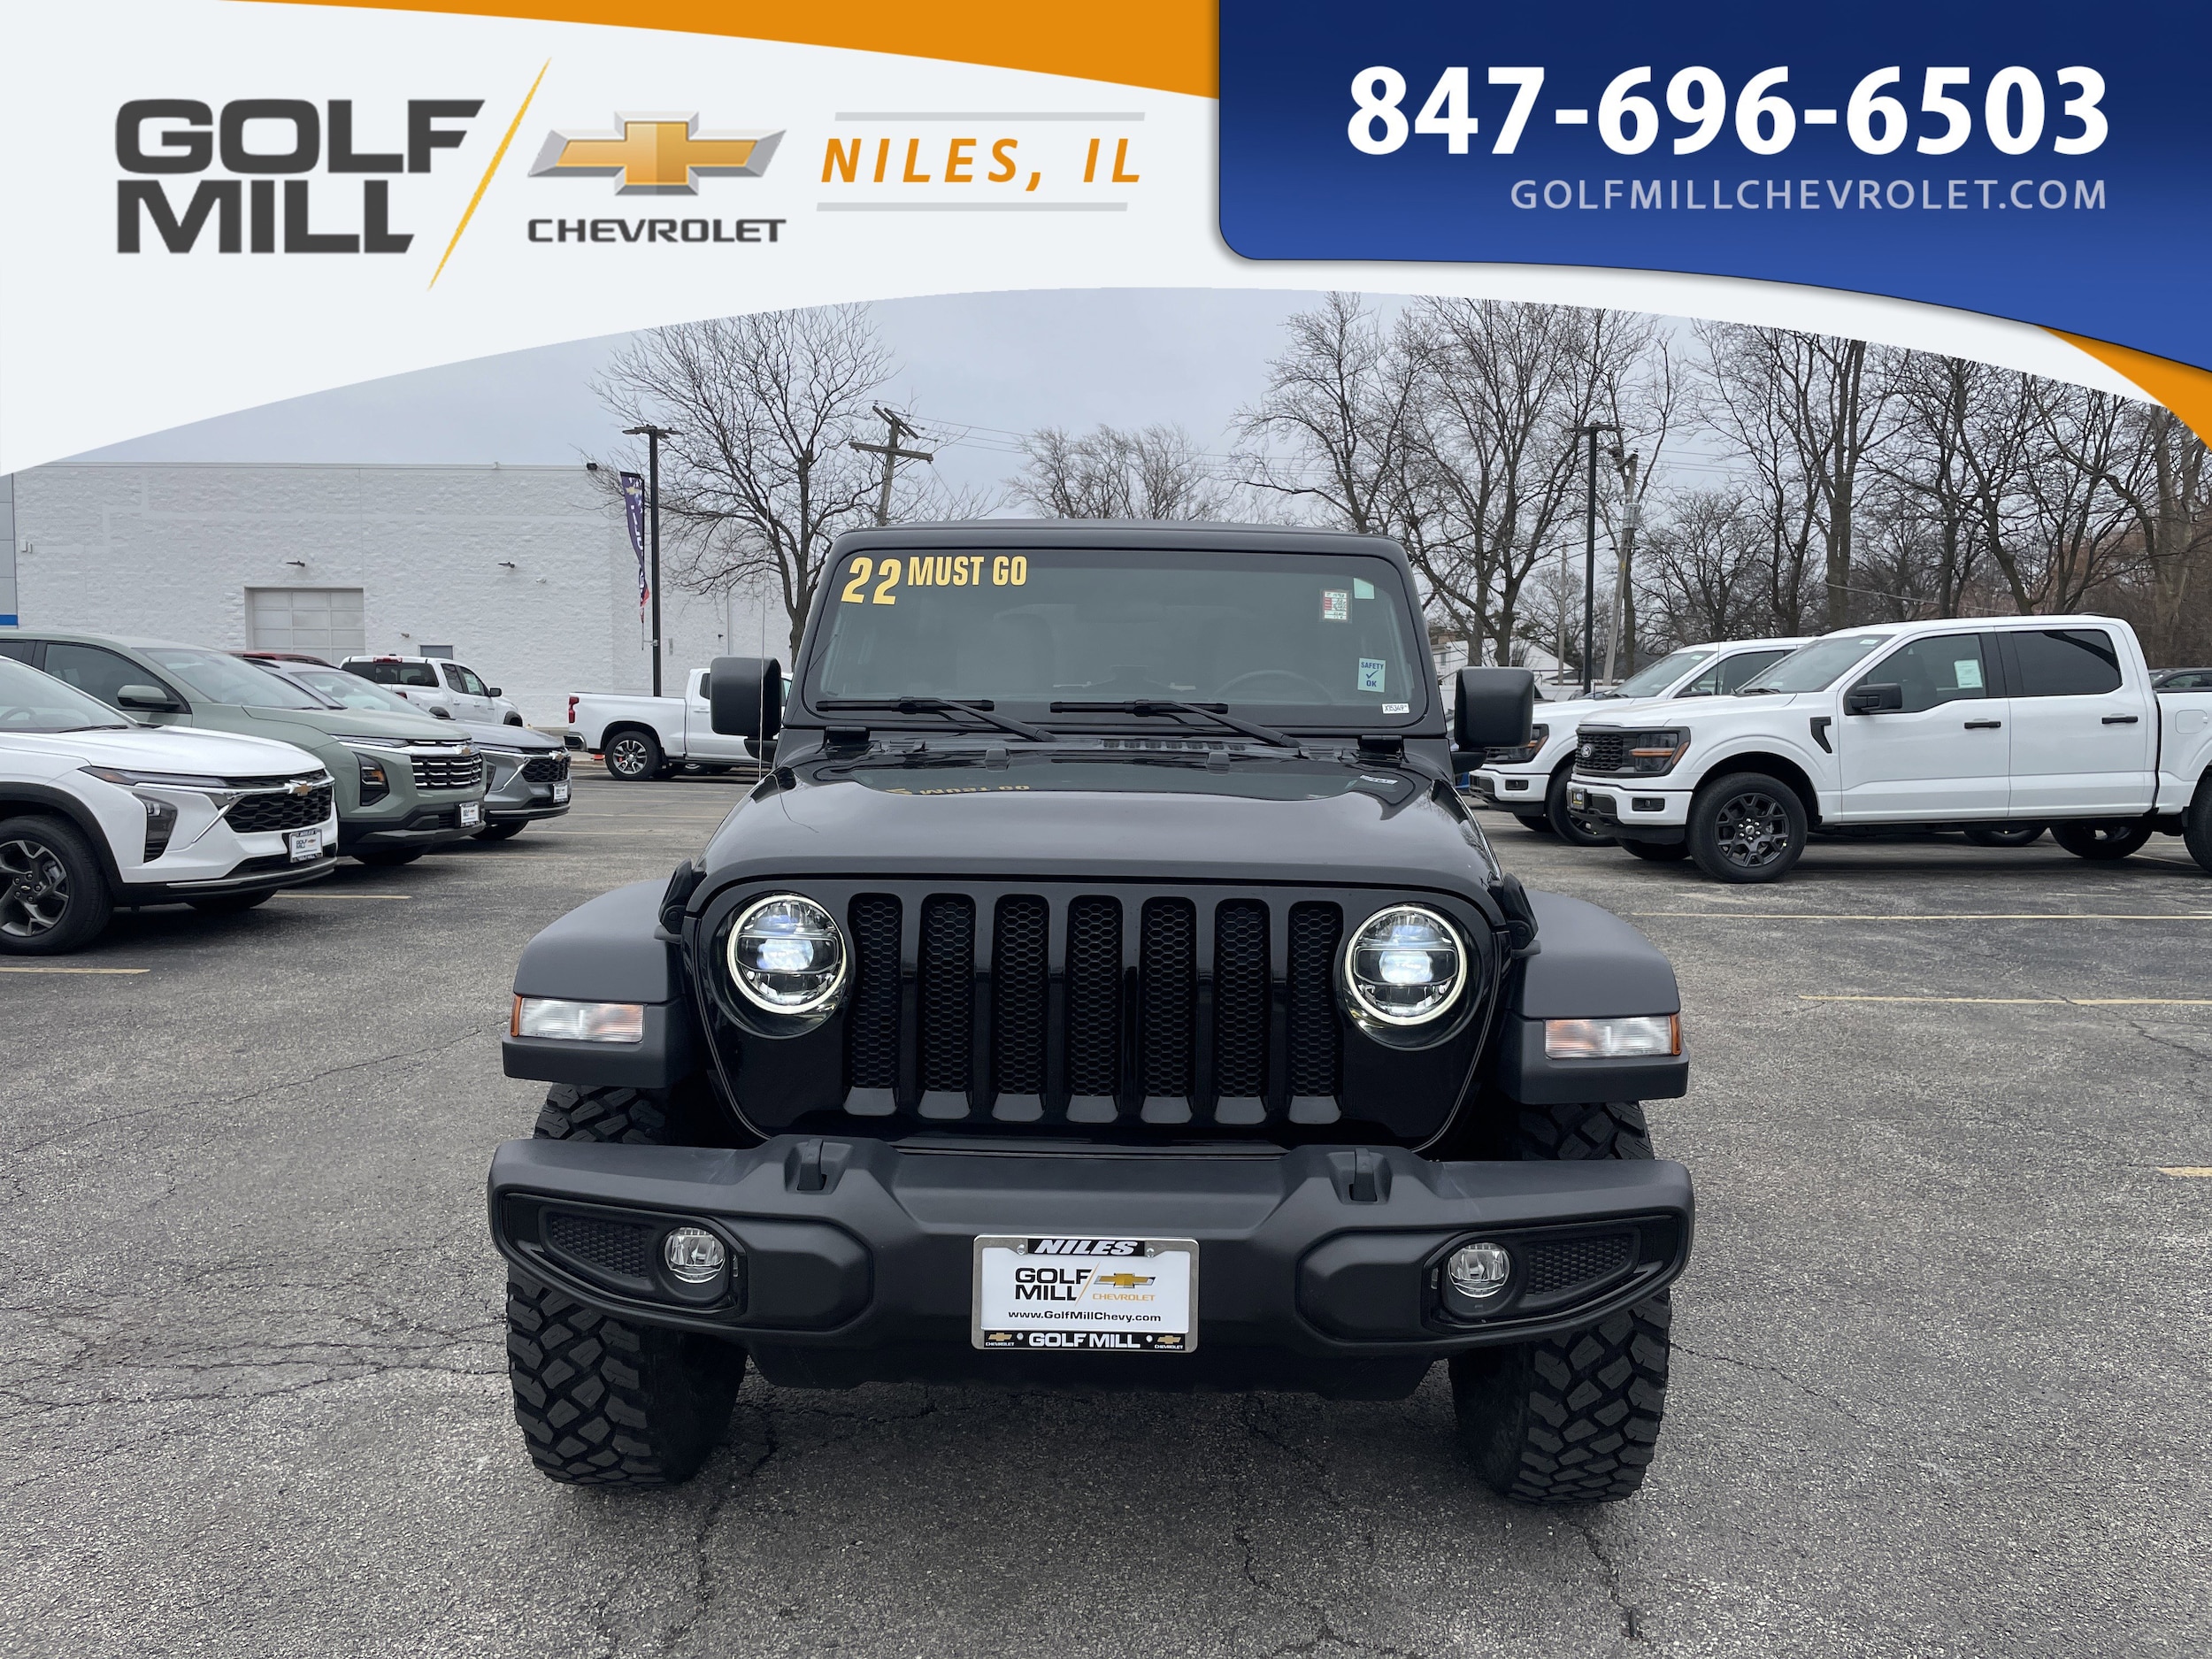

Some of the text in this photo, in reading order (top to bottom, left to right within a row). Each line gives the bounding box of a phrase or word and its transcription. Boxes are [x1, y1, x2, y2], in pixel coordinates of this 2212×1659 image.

[841, 556, 1028, 605] 22 MUST GO
[1034, 1240, 1138, 1256] NILES
[1015, 1268, 1092, 1284] GOLF
[1015, 1285, 1077, 1301] MILL
[1093, 1293, 1156, 1302] CHEVROLET
[1008, 1310, 1162, 1323] www.GolfMillChevy.com
[1028, 1333, 1141, 1348] GOLF MILL
